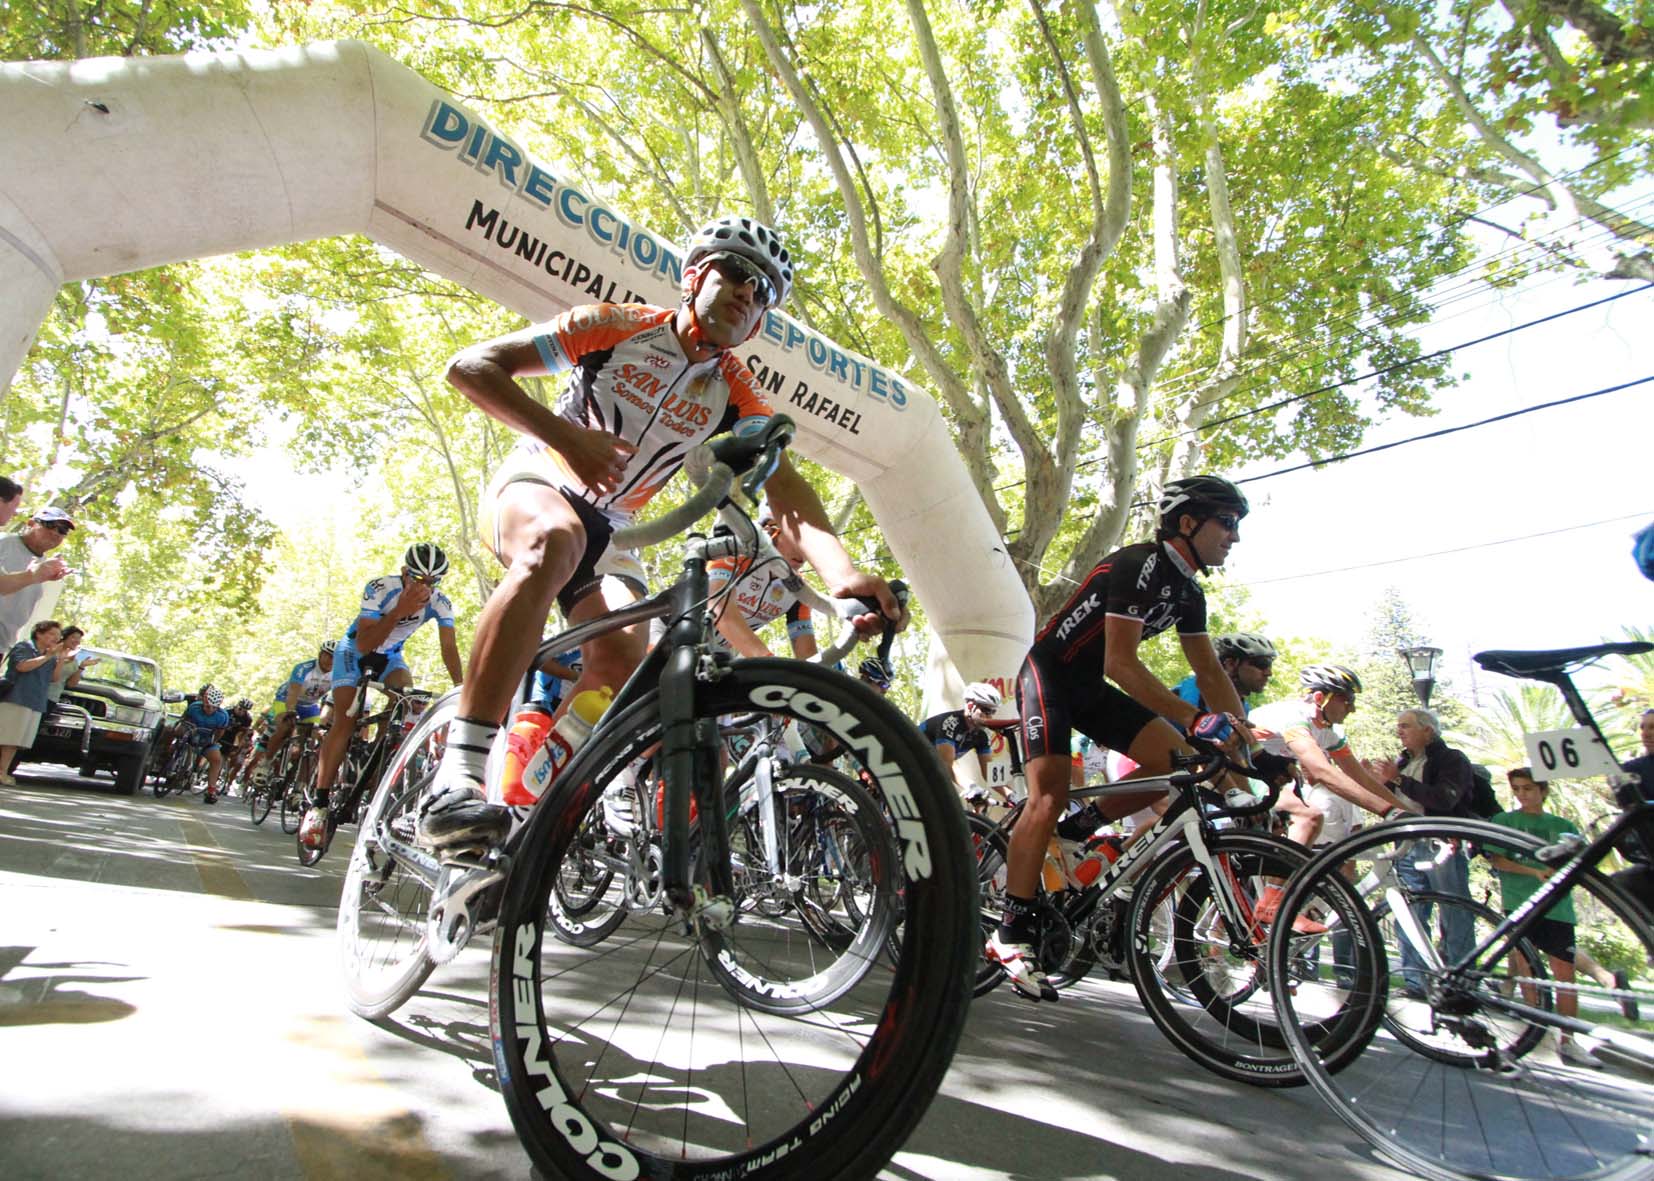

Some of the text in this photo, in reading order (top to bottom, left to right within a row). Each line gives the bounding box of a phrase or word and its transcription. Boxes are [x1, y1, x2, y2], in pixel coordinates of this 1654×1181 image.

[420, 99, 909, 411] DIRECCION EPORTES
[611, 382, 656, 415] Somos
[657, 412, 697, 438] Todos
[613, 363, 668, 398] SAN
[661, 392, 712, 427] LUIS
[746, 353, 786, 395] SAN
[789, 381, 864, 435] RAFAEL
[1055, 592, 1101, 641] TREK
[1027, 715, 1044, 741] Clos
[1538, 738, 1580, 771] 06
[749, 684, 933, 883] COLNER
[772, 777, 859, 815] OLNER
[992, 766, 1005, 783] 81
[1098, 817, 1168, 890] TREK
[512, 921, 640, 1181] COLNER
